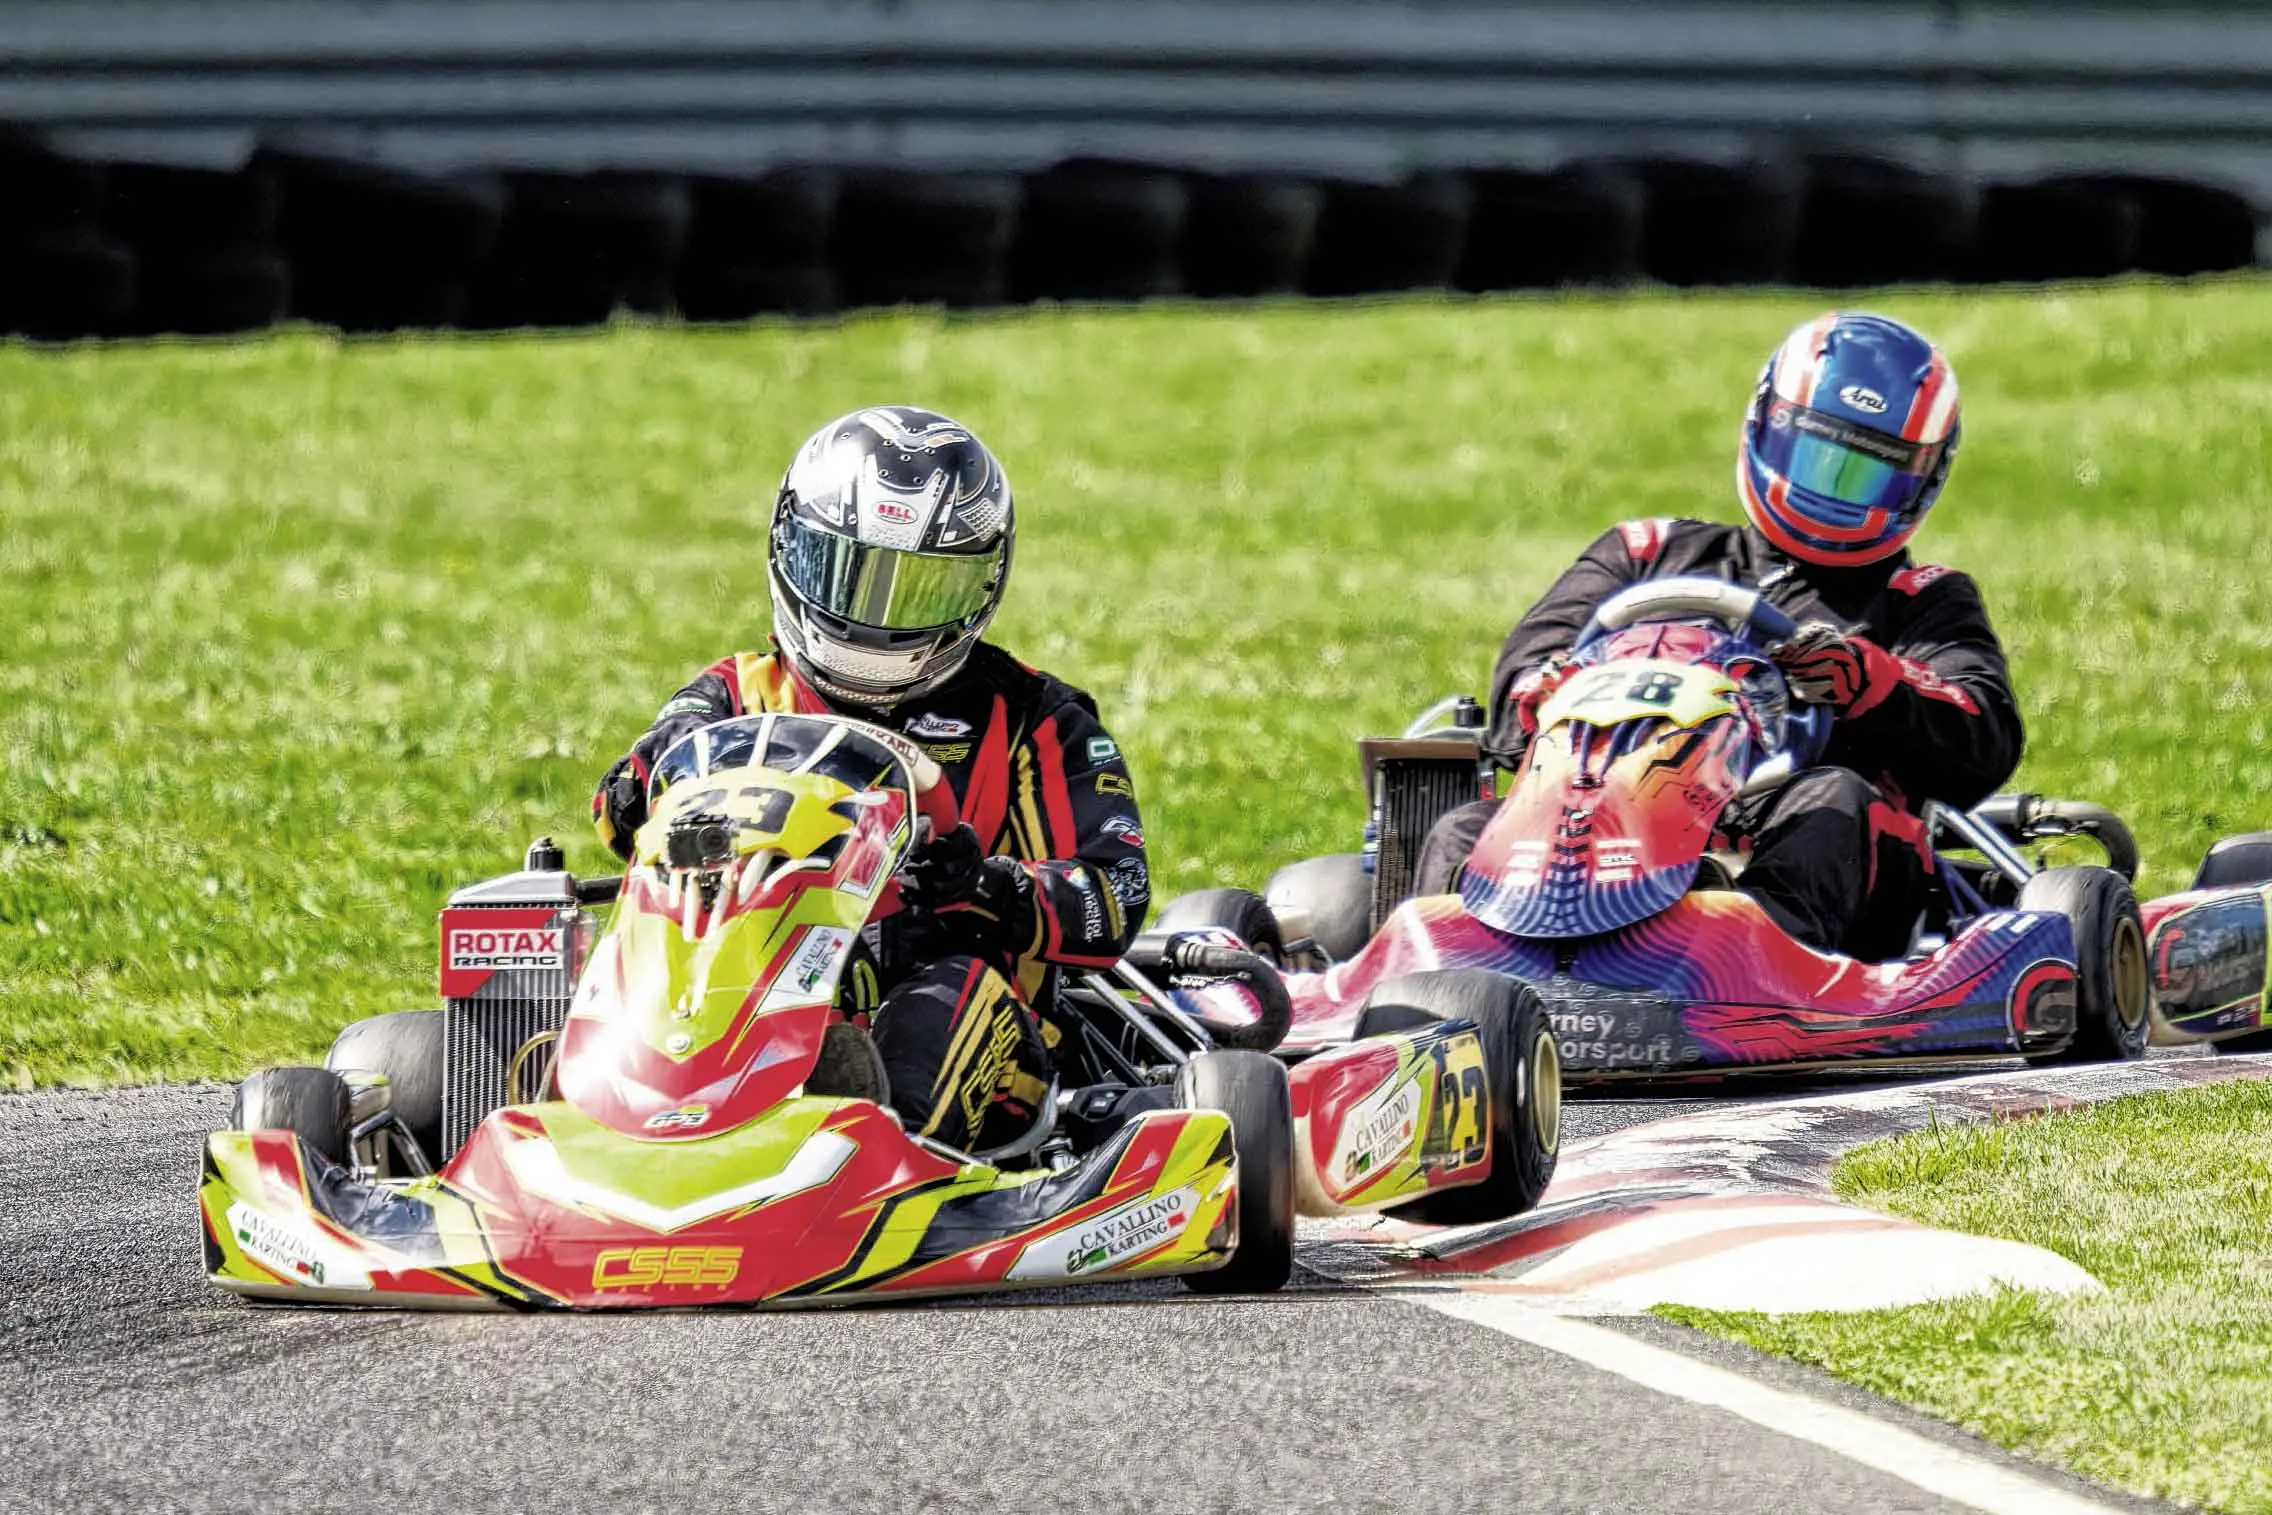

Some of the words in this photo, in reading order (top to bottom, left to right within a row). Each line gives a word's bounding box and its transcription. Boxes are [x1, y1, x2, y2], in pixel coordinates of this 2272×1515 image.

[1850, 388, 1885, 410] Arai
[878, 504, 912, 519] BELL
[1571, 671, 1684, 708] 28
[454, 932, 557, 954] ROTAX
[454, 956, 557, 967] RACING
[1549, 1013, 1616, 1041] rney
[1560, 1040, 1673, 1068] orsport
[1354, 1093, 1410, 1153] CAVALLINO
[1442, 1065, 1488, 1170] 23
[1080, 1194, 1181, 1251] CAVALLINO
[1107, 1222, 1168, 1257] KARTING
[591, 1246, 745, 1288] CSSS
